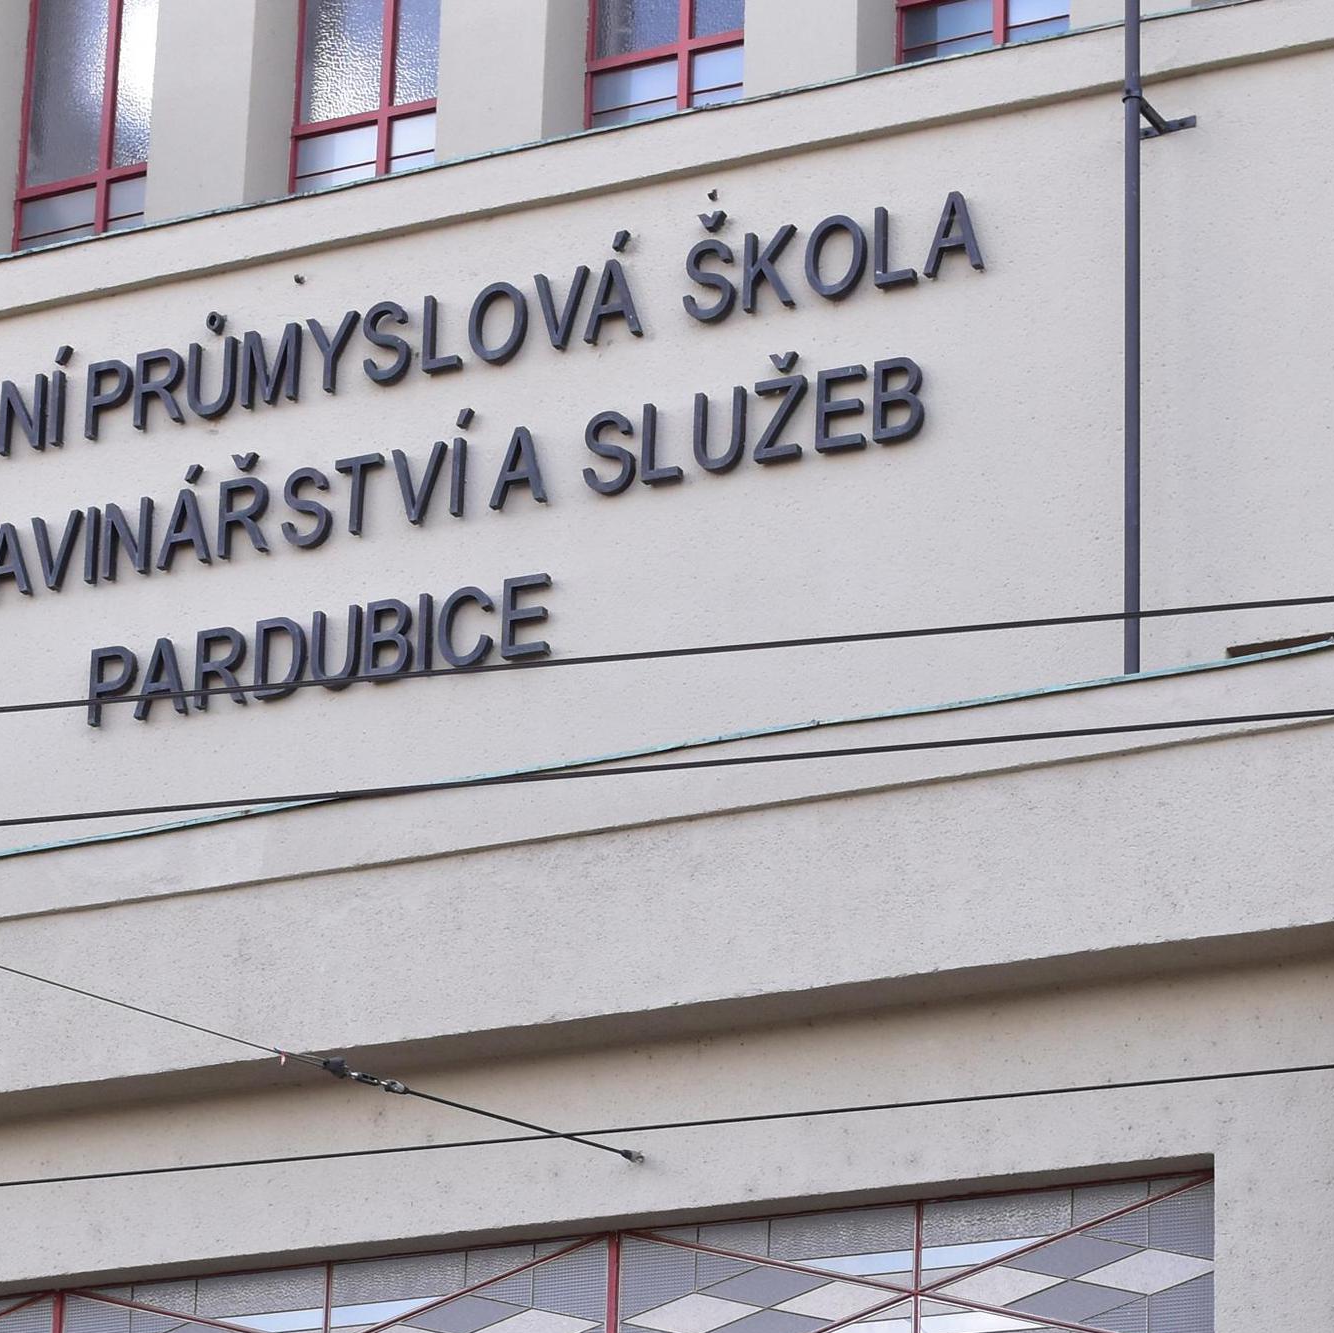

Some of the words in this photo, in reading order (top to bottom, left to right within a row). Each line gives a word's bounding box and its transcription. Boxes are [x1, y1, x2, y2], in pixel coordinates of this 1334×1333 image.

[83, 228, 646, 444] PRŮMYSLOVÁ
[681, 190, 986, 328] ŠKOLA
[487, 425, 550, 513] A
[581, 350, 927, 500] SLUŽEB
[85, 571, 553, 728] PARDUBICE
